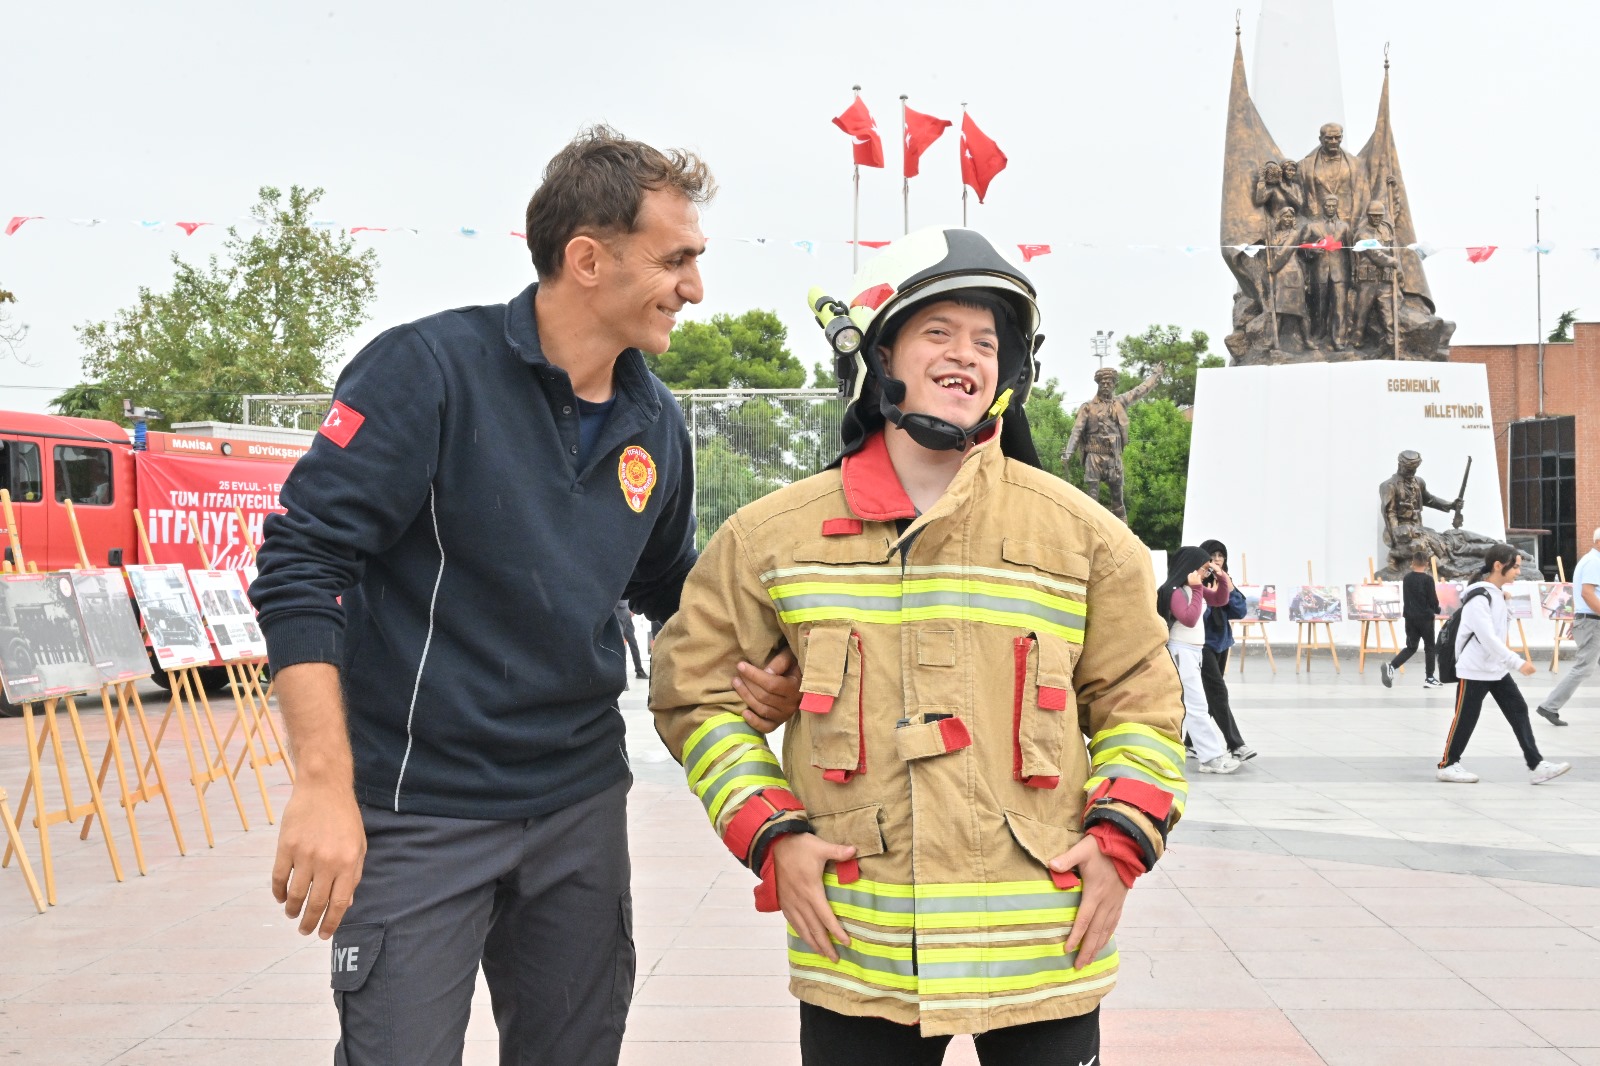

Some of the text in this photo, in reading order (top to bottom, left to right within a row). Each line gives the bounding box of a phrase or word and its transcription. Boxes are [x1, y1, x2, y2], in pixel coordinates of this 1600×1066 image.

[1387, 376, 1440, 393] EGEMENLİK
[1424, 402, 1484, 419] MİLLETİNDİR
[172, 438, 213, 451] MANİSA
[219, 481, 230, 490] 25
[268, 484, 272, 492] 1
[203, 492, 288, 510] İTFAİYECİLE
[149, 508, 240, 545] İTFAİYE
